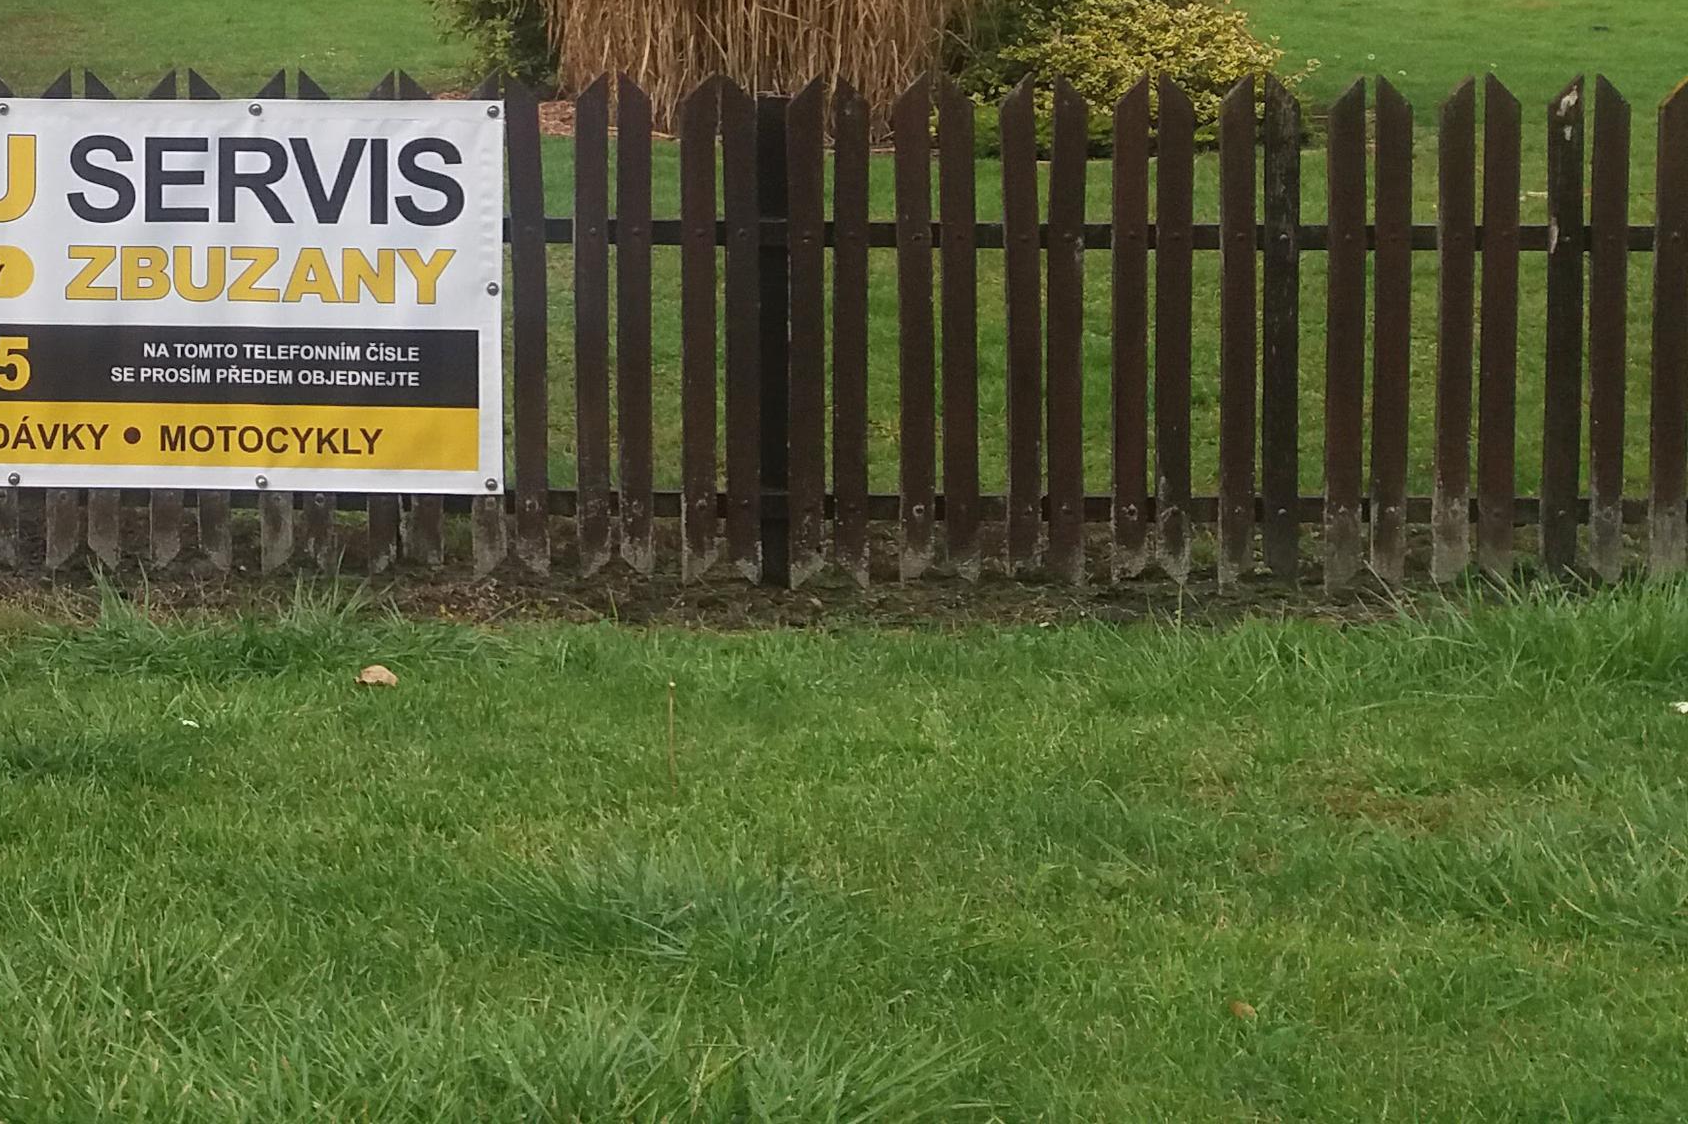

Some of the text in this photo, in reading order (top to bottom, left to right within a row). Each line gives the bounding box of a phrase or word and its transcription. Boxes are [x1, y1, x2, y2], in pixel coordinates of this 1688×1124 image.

[66, 134, 465, 226] SERVIS
[65, 244, 457, 304] ZBUZANY
[143, 341, 420, 362] NA TOMTO TELEFONNÍM ČÍSLE
[110, 364, 420, 387] SE PROSÍM PŘEDEM OBJEDNEJTE
[159, 426, 383, 455] MOTOCYKLY
